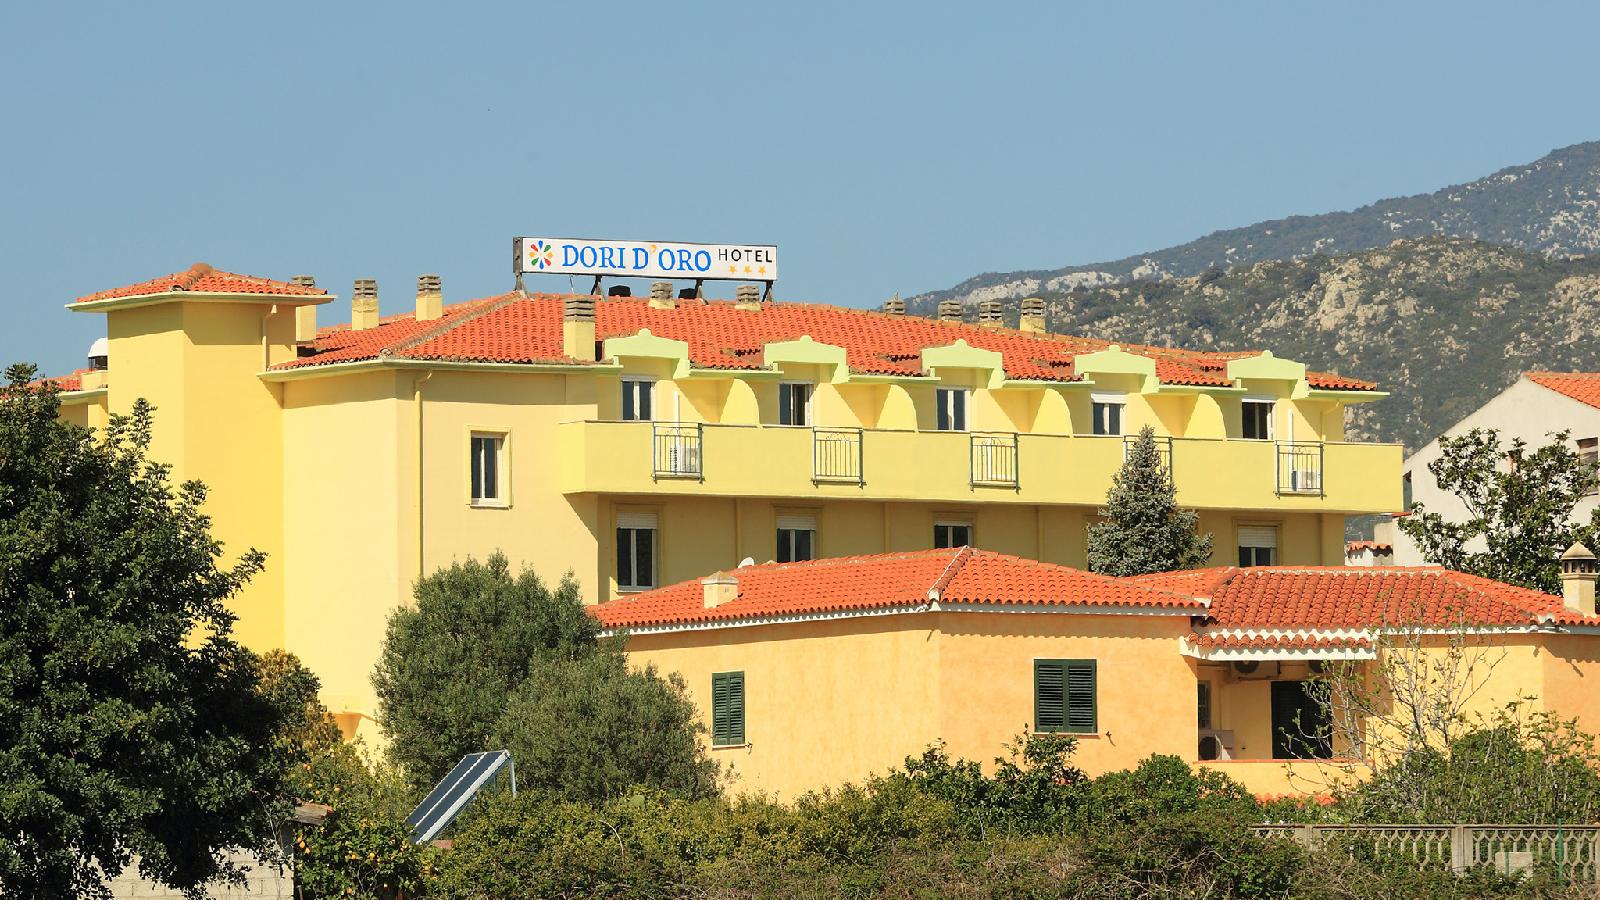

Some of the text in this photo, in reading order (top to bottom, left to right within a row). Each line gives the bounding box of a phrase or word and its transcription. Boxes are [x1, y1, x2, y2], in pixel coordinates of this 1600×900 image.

[562, 244, 773, 272] DORI D'ORO HOTEL
